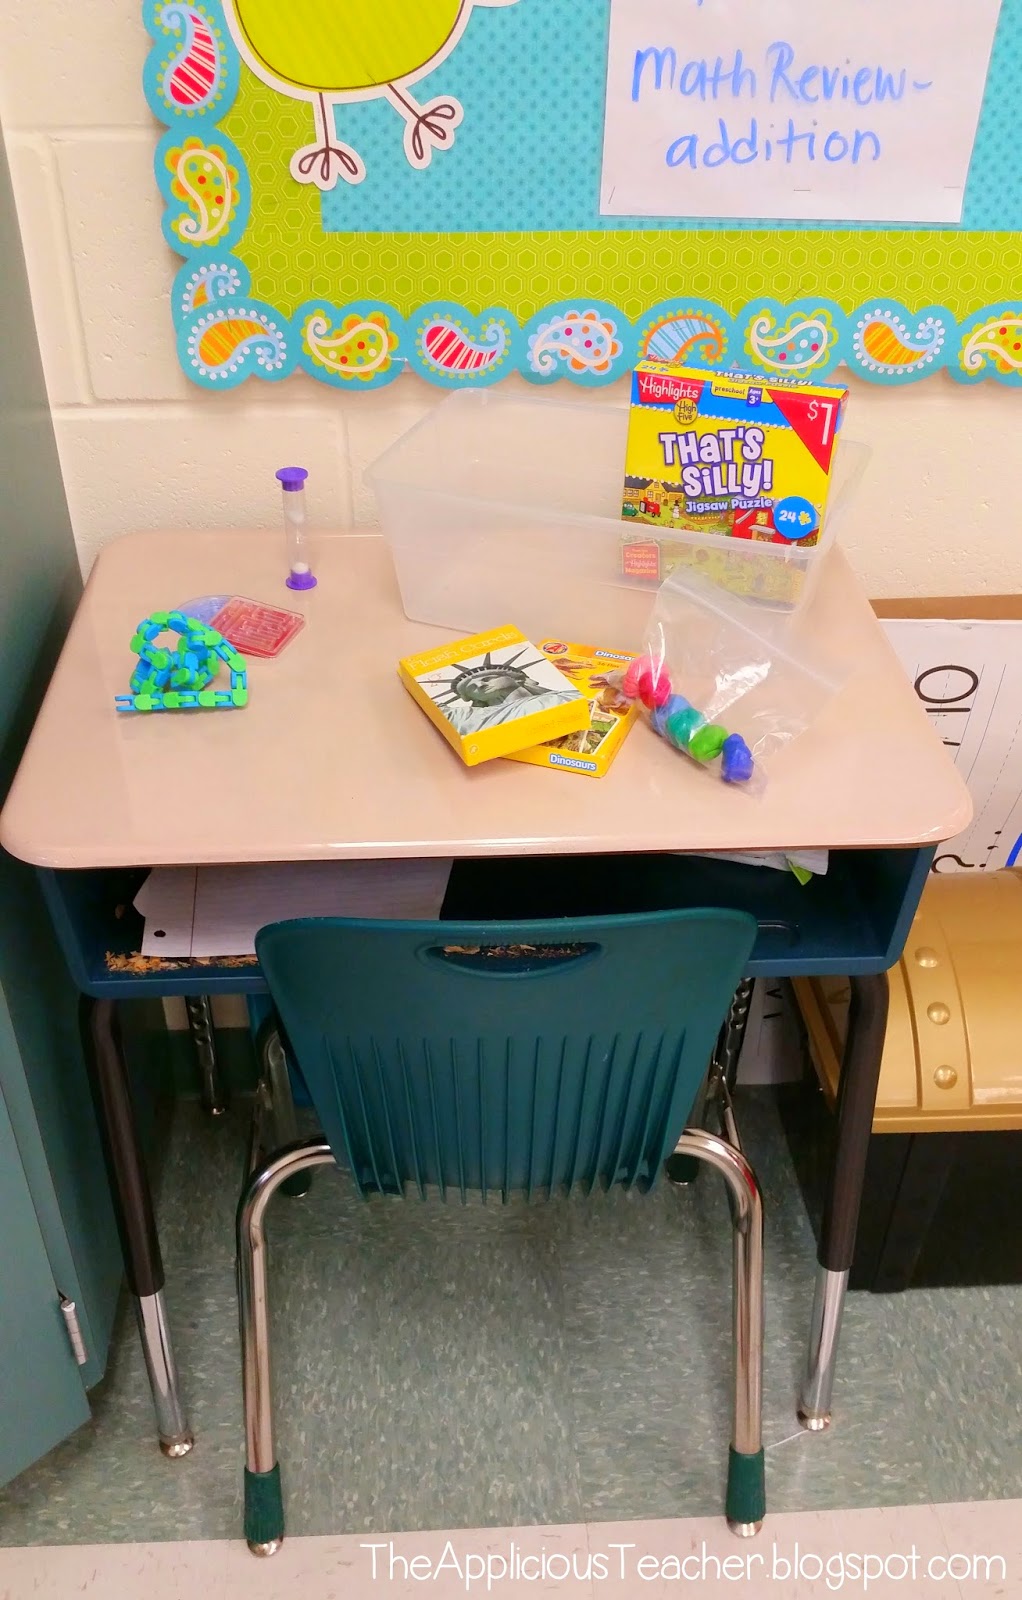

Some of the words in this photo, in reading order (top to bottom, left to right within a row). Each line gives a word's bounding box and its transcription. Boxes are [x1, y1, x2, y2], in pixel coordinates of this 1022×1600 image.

[632, 45, 756, 103] Math
[666, 117, 881, 170] addition
[639, 376, 699, 400] Highlights
[714, 385, 746, 396] preschool
[677, 411, 693, 421] Five
[679, 402, 697, 415] High
[685, 500, 728, 513] Jigsaw
[731, 497, 773, 510] Puzzle
[778, 509, 796, 523] 24
[408, 648, 458, 671] Flash
[595, 650, 636, 661] Dinosa
[549, 753, 597, 772] Dinosaurs
